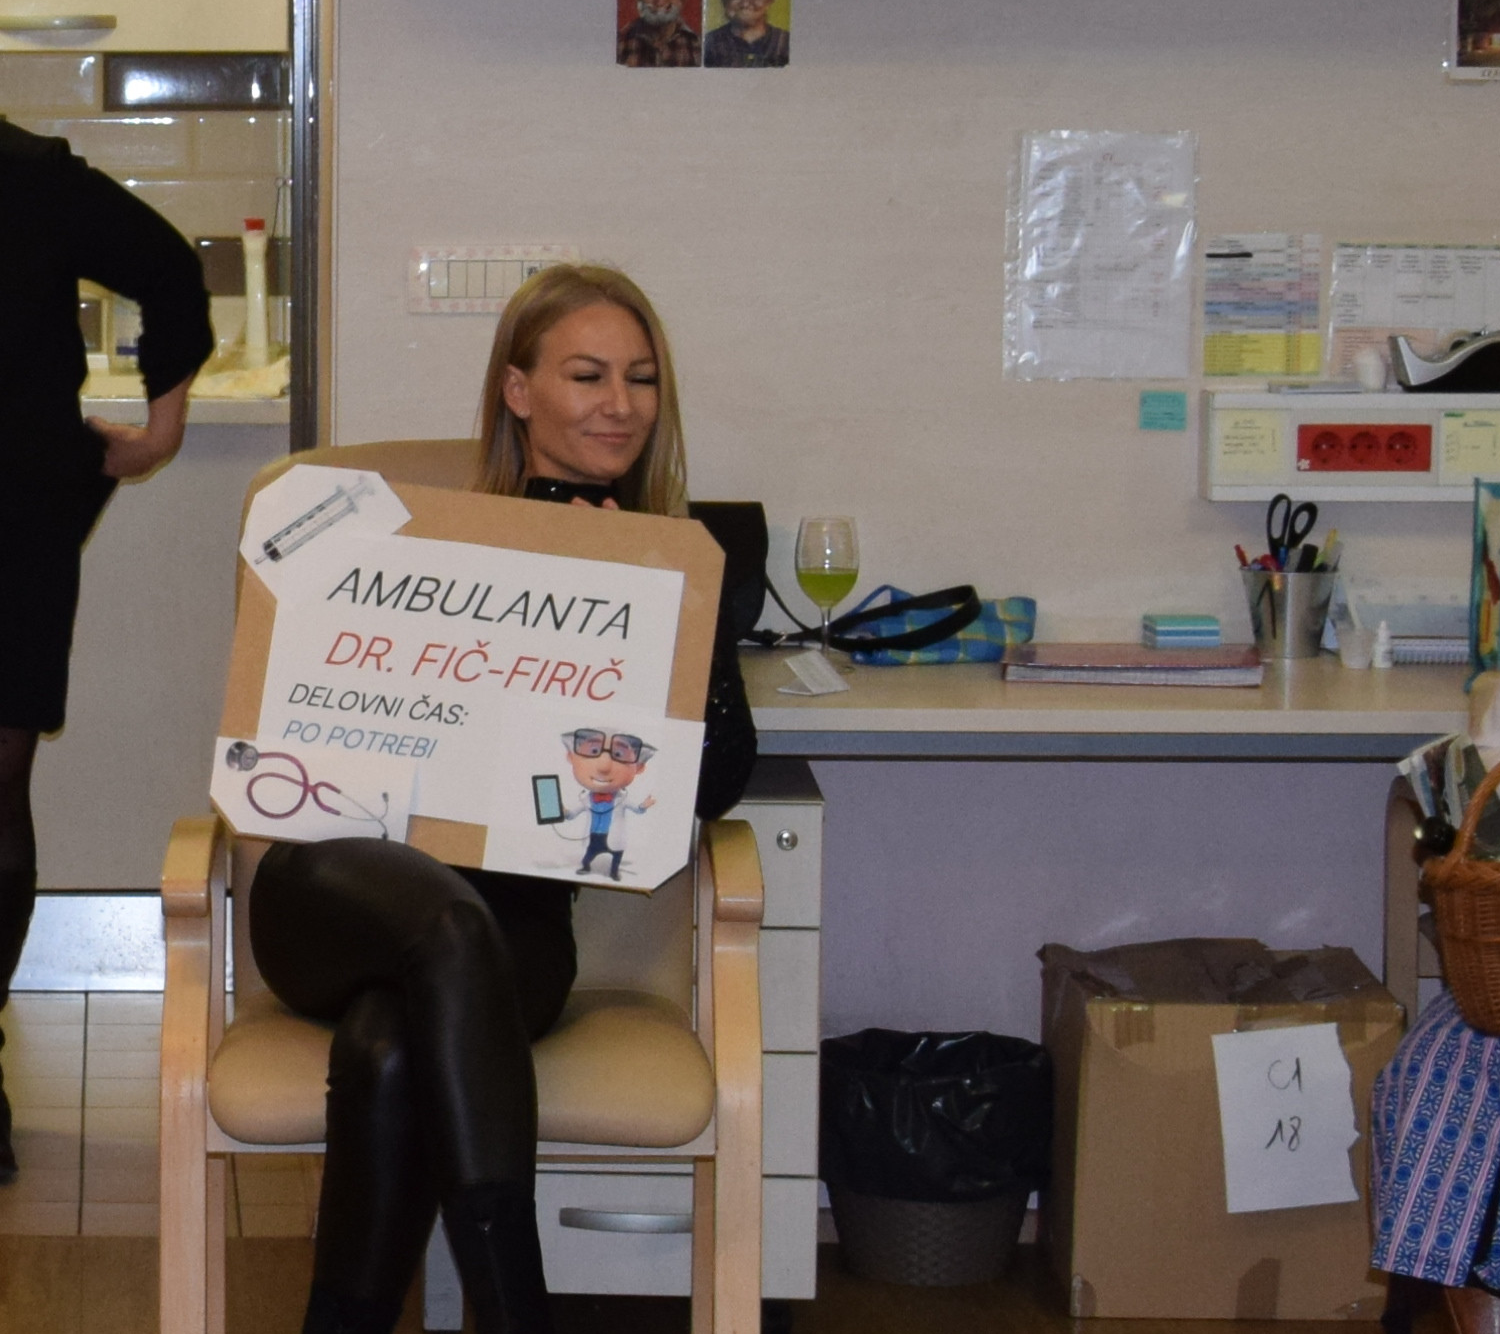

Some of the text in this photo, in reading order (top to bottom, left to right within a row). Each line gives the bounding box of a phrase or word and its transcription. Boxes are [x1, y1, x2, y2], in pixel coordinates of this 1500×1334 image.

[326, 567, 632, 640] AMBULANTA
[324, 631, 626, 702] DR. FIČ-FIRIČ
[288, 682, 470, 727] DELOVNI ČAS:
[282, 719, 438, 759] PO POTREBI
